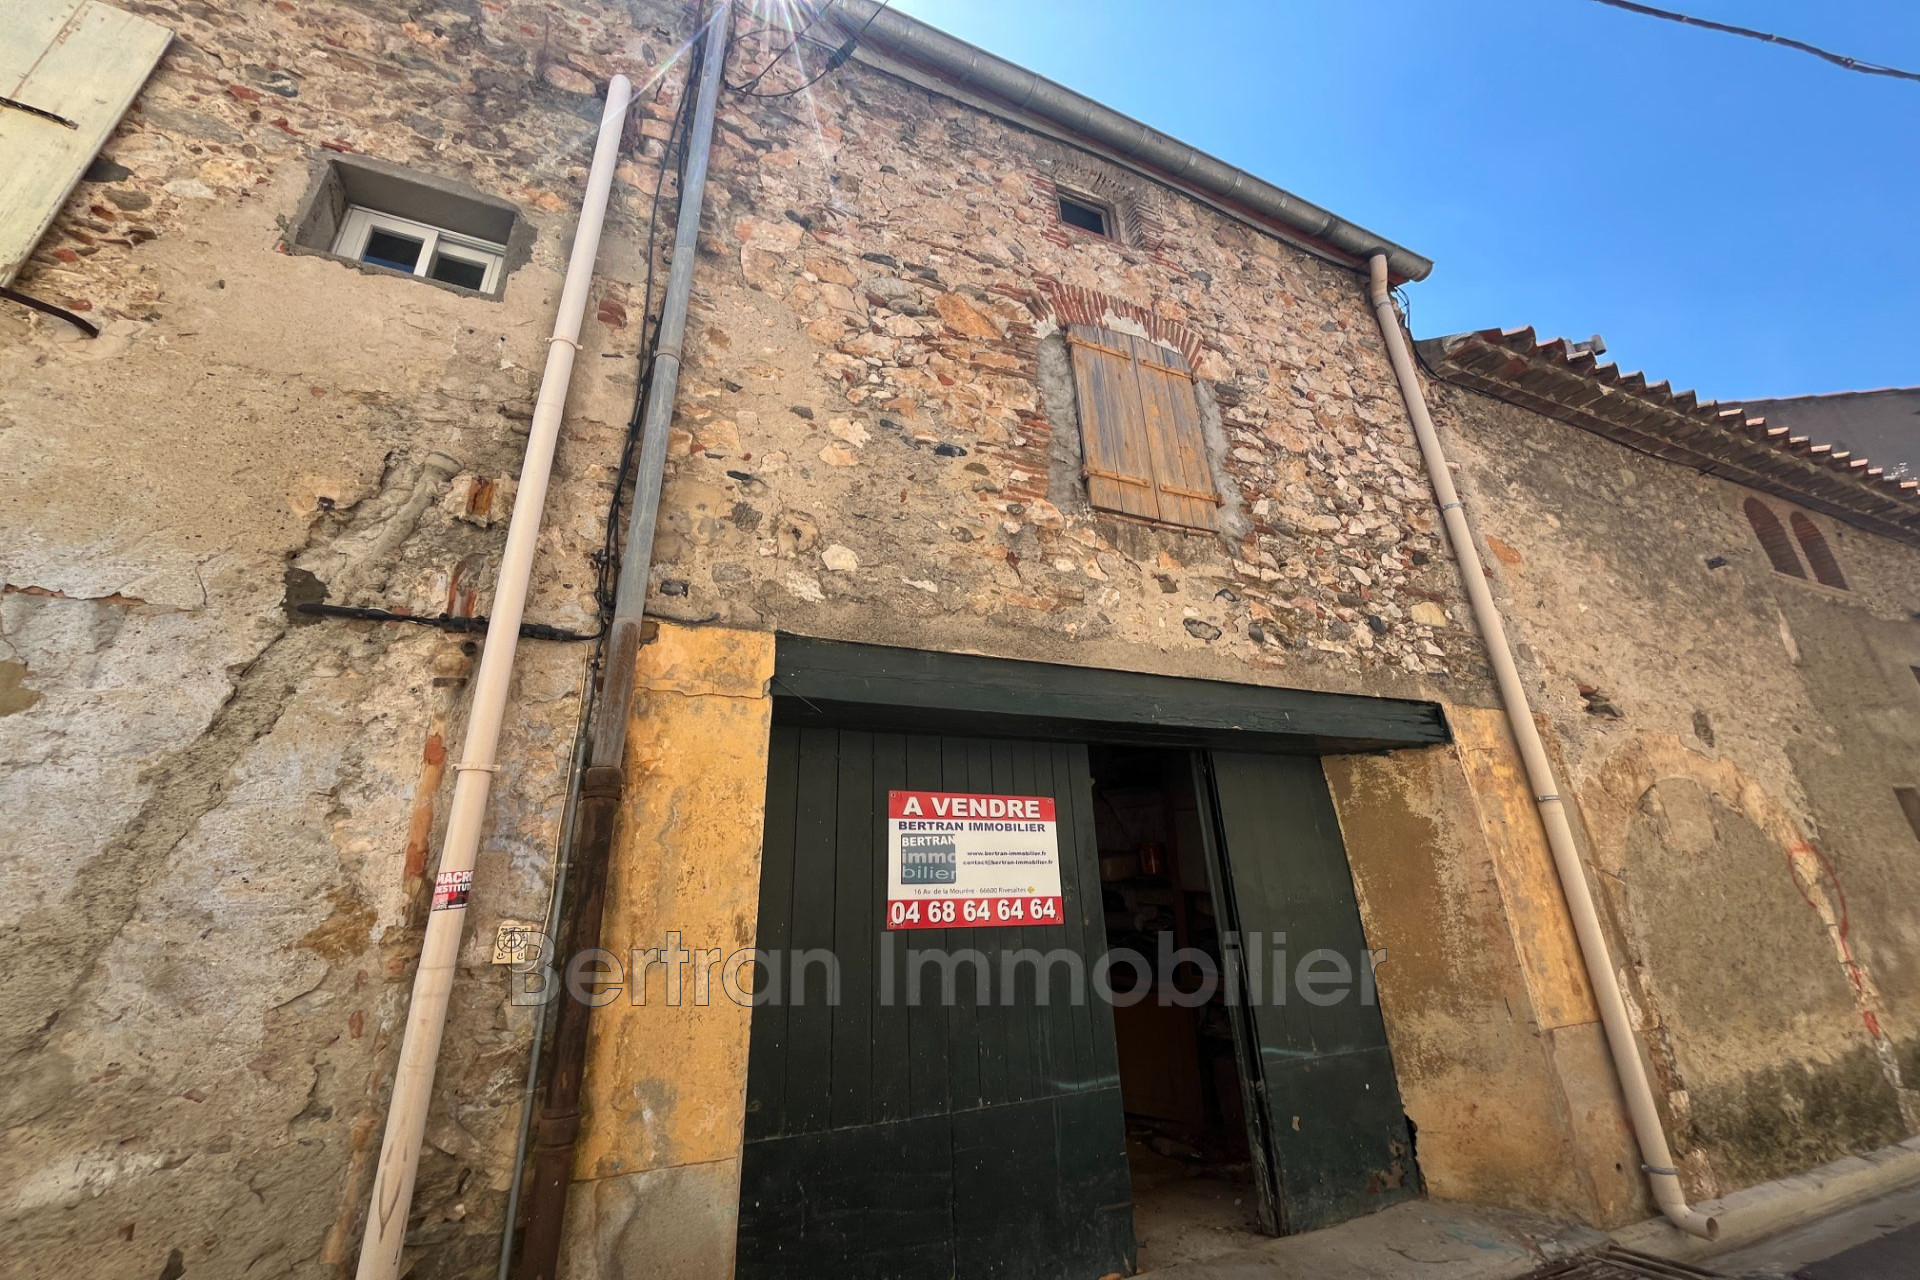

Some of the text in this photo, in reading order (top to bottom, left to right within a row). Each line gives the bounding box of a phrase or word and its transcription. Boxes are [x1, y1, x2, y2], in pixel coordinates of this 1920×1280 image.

[902, 796, 1041, 819] A VENDRE
[898, 821, 1046, 832] BERTRAN IMMOBILIER
[902, 835, 956, 847] BERTRAN
[998, 886, 1027, 894] Rivesaltes
[891, 898, 1056, 924] 04 68 64 64 64
